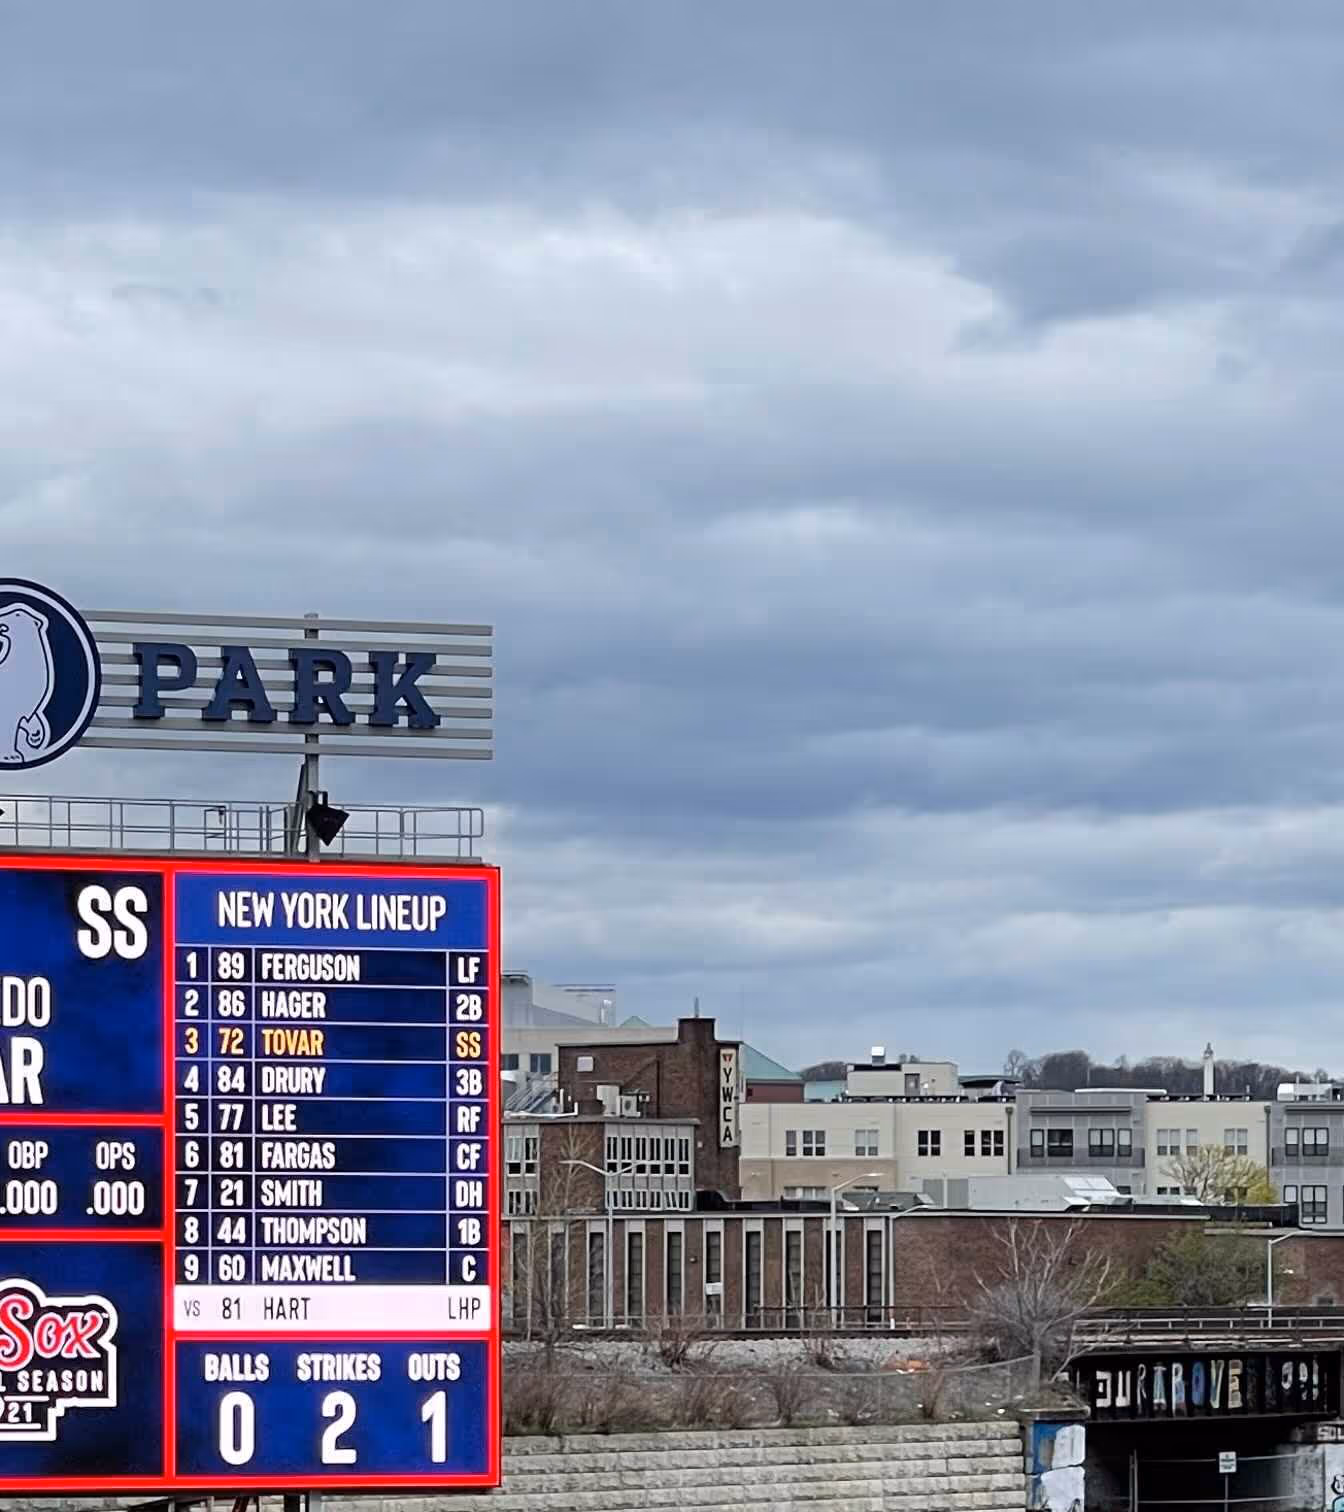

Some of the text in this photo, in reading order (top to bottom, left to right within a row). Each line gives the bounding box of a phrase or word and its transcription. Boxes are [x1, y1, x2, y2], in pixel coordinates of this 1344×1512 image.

[132, 641, 442, 730] PARK
[77, 885, 148, 959] SS
[218, 891, 446, 932] NEW YORK LINEUP
[186, 951, 481, 984] 1 89 FERGUSON LF
[184, 988, 483, 1021] 2 86 HAGER 2B
[184, 1027, 481, 1058] 3 72 TOVAR SS
[183, 1065, 483, 1096] 4 84 DRURY 3B
[185, 1103, 482, 1133] 5 77 LEE RF
[722, 1067, 733, 1142] YWCA
[8, 1140, 49, 1169] OBP
[95, 1141, 136, 1170] OPS
[185, 1140, 482, 1170] 6 81 FARGAS CF
[86, 1180, 145, 1216] .000
[184, 1178, 483, 1208] 7 21 SMITH DH
[184, 1216, 481, 1246] 8 44 THOMPSON 1B
[184, 1254, 476, 1282] 9 60 MAXWELL C
[221, 1297, 241, 1320] 81
[263, 1297, 311, 1320] HART
[448, 1297, 482, 1320] LHP
[17, 1369, 103, 1393] SEASON
[204, 1352, 461, 1382] BALLS STRIKES OUTS
[219, 1390, 446, 1465] 0 2 1
